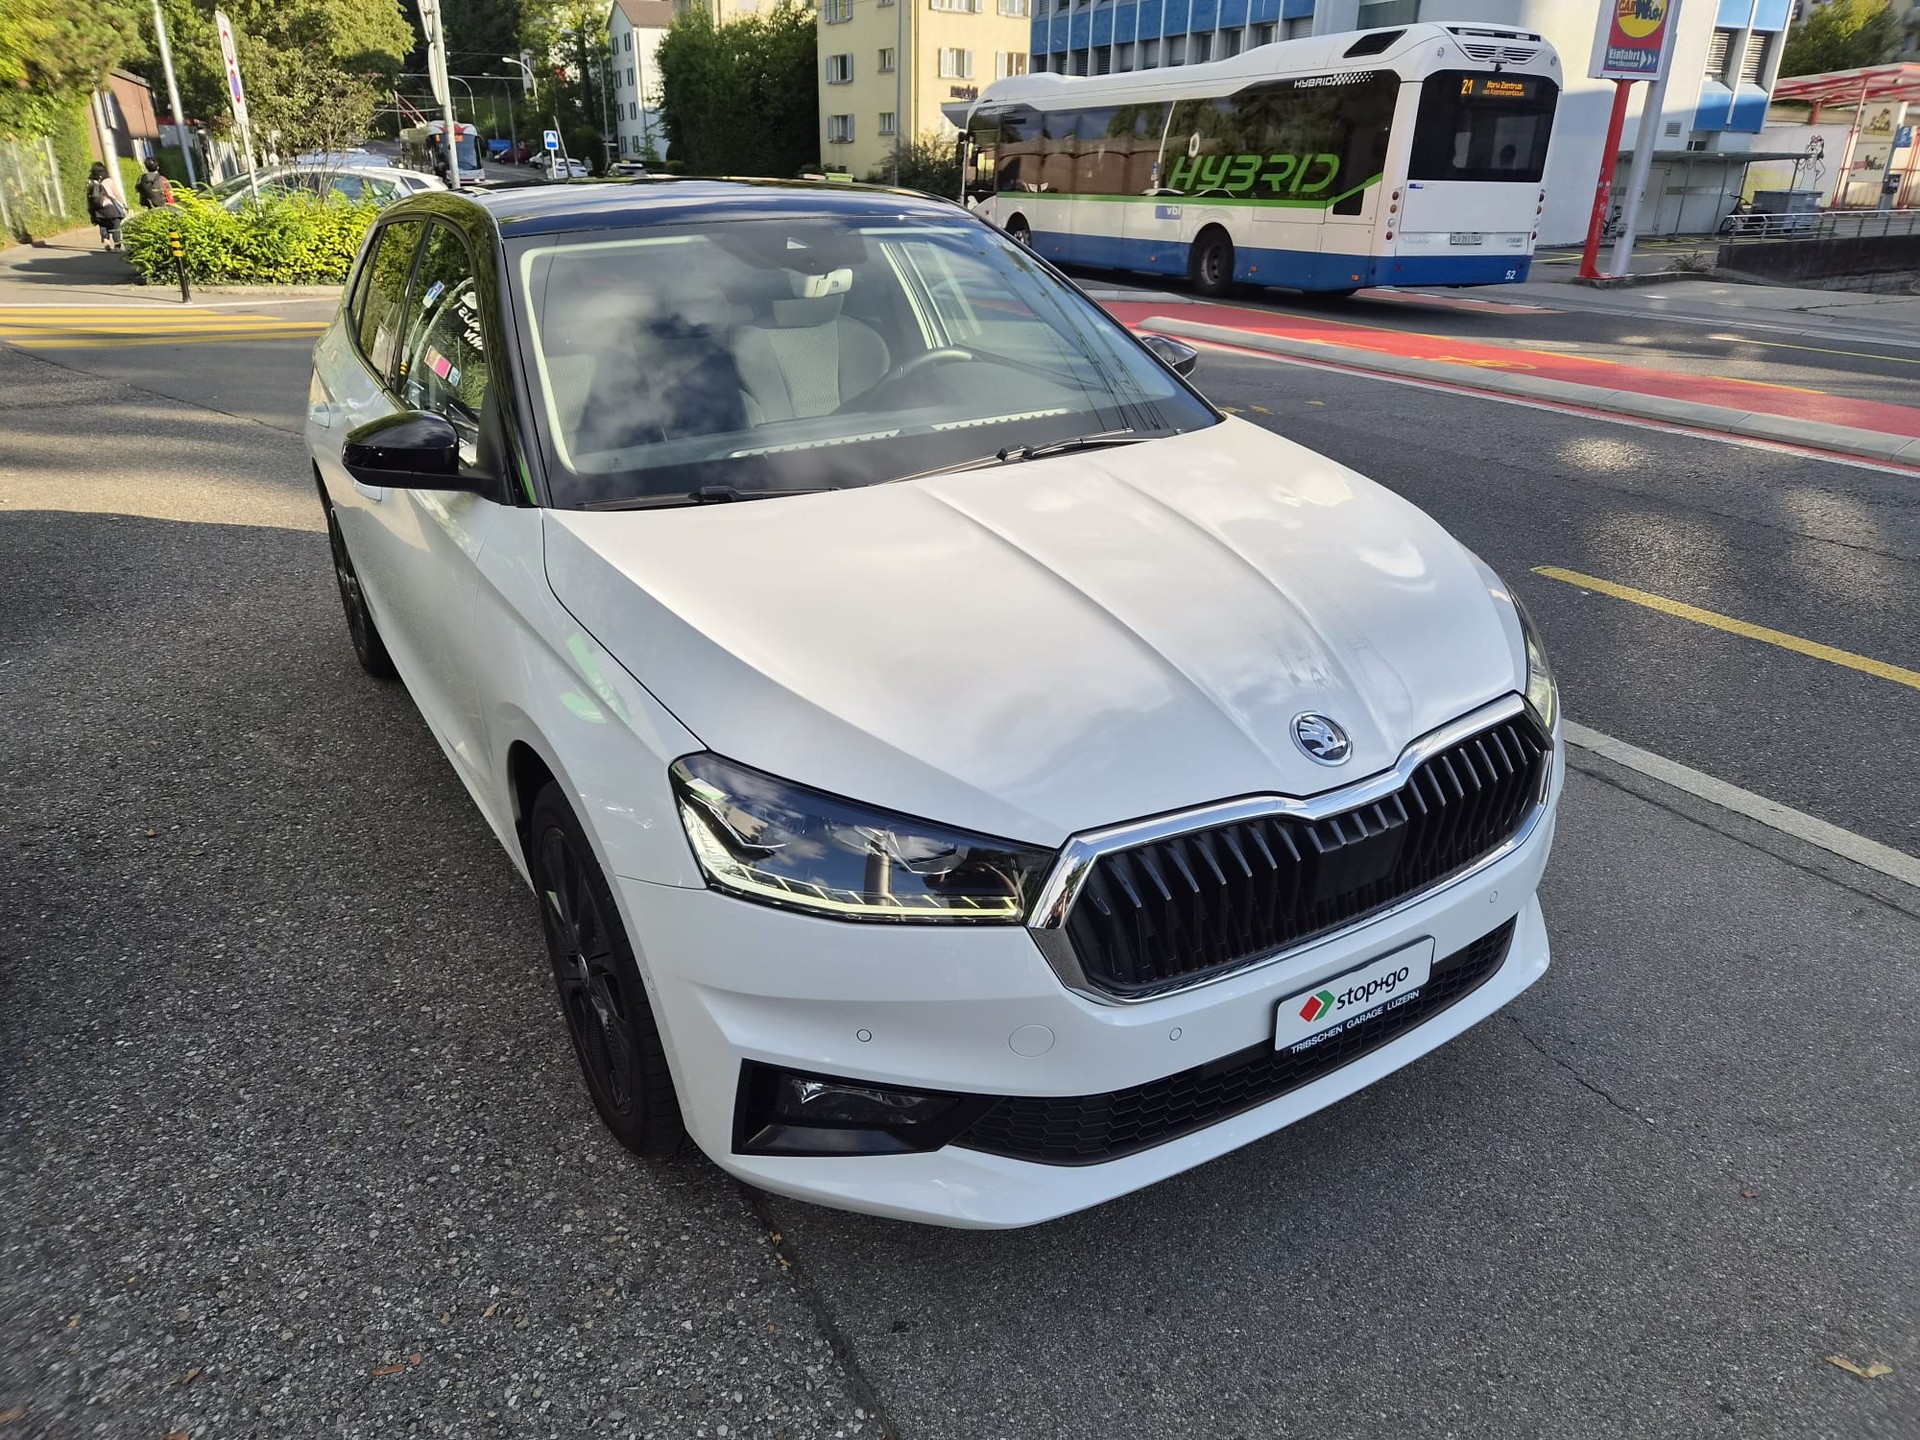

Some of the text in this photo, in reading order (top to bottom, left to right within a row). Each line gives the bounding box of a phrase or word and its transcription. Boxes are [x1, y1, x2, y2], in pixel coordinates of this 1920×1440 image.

[1609, 48, 1640, 60] Einfahrt
[1294, 75, 1333, 88] HYBRID
[1461, 79, 1474, 95] 21
[1167, 153, 1340, 193] HYBRID
[1505, 270, 1516, 280] 52
[1336, 966, 1409, 1010] stop+go
[1291, 990, 1420, 1054] TRIBSCHEN GARAGE LUZERN
